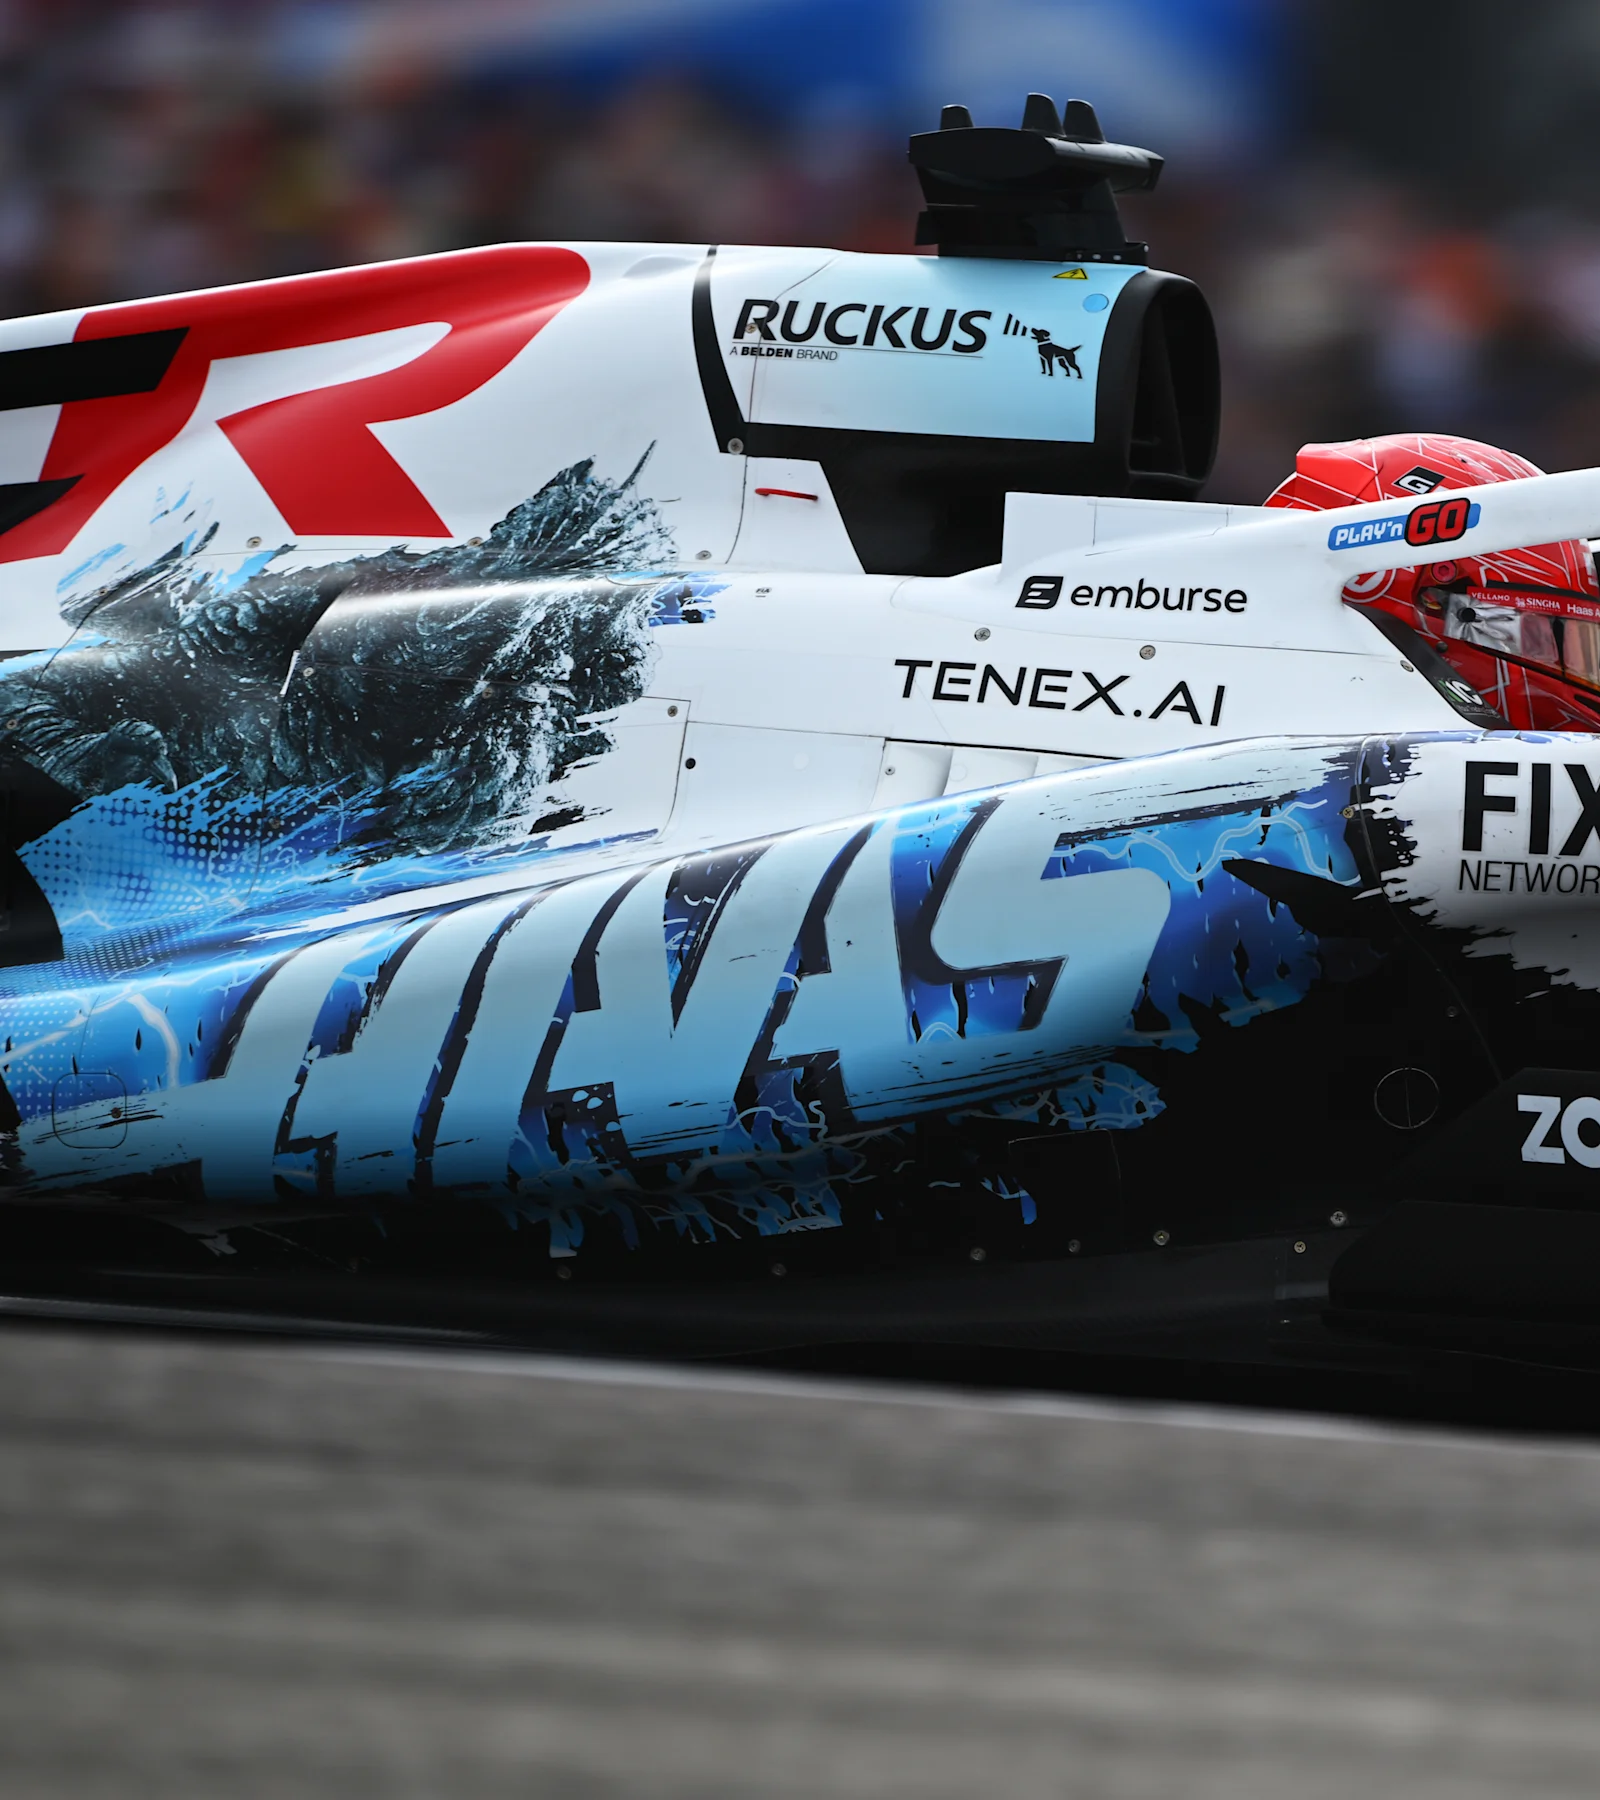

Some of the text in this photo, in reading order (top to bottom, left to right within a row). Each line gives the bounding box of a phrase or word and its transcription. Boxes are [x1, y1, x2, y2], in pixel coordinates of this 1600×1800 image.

[733, 298, 992, 353] RUCKUS
[729, 347, 838, 361] A BELDEN BRAND
[1407, 498, 1468, 545] GO
[1071, 578, 1248, 613] emburse
[1471, 592, 1510, 602] VELLAMO
[1526, 597, 1561, 609] SINGHA
[1567, 603, 1594, 616] Haas
[894, 659, 1226, 727] TENEX.AI
